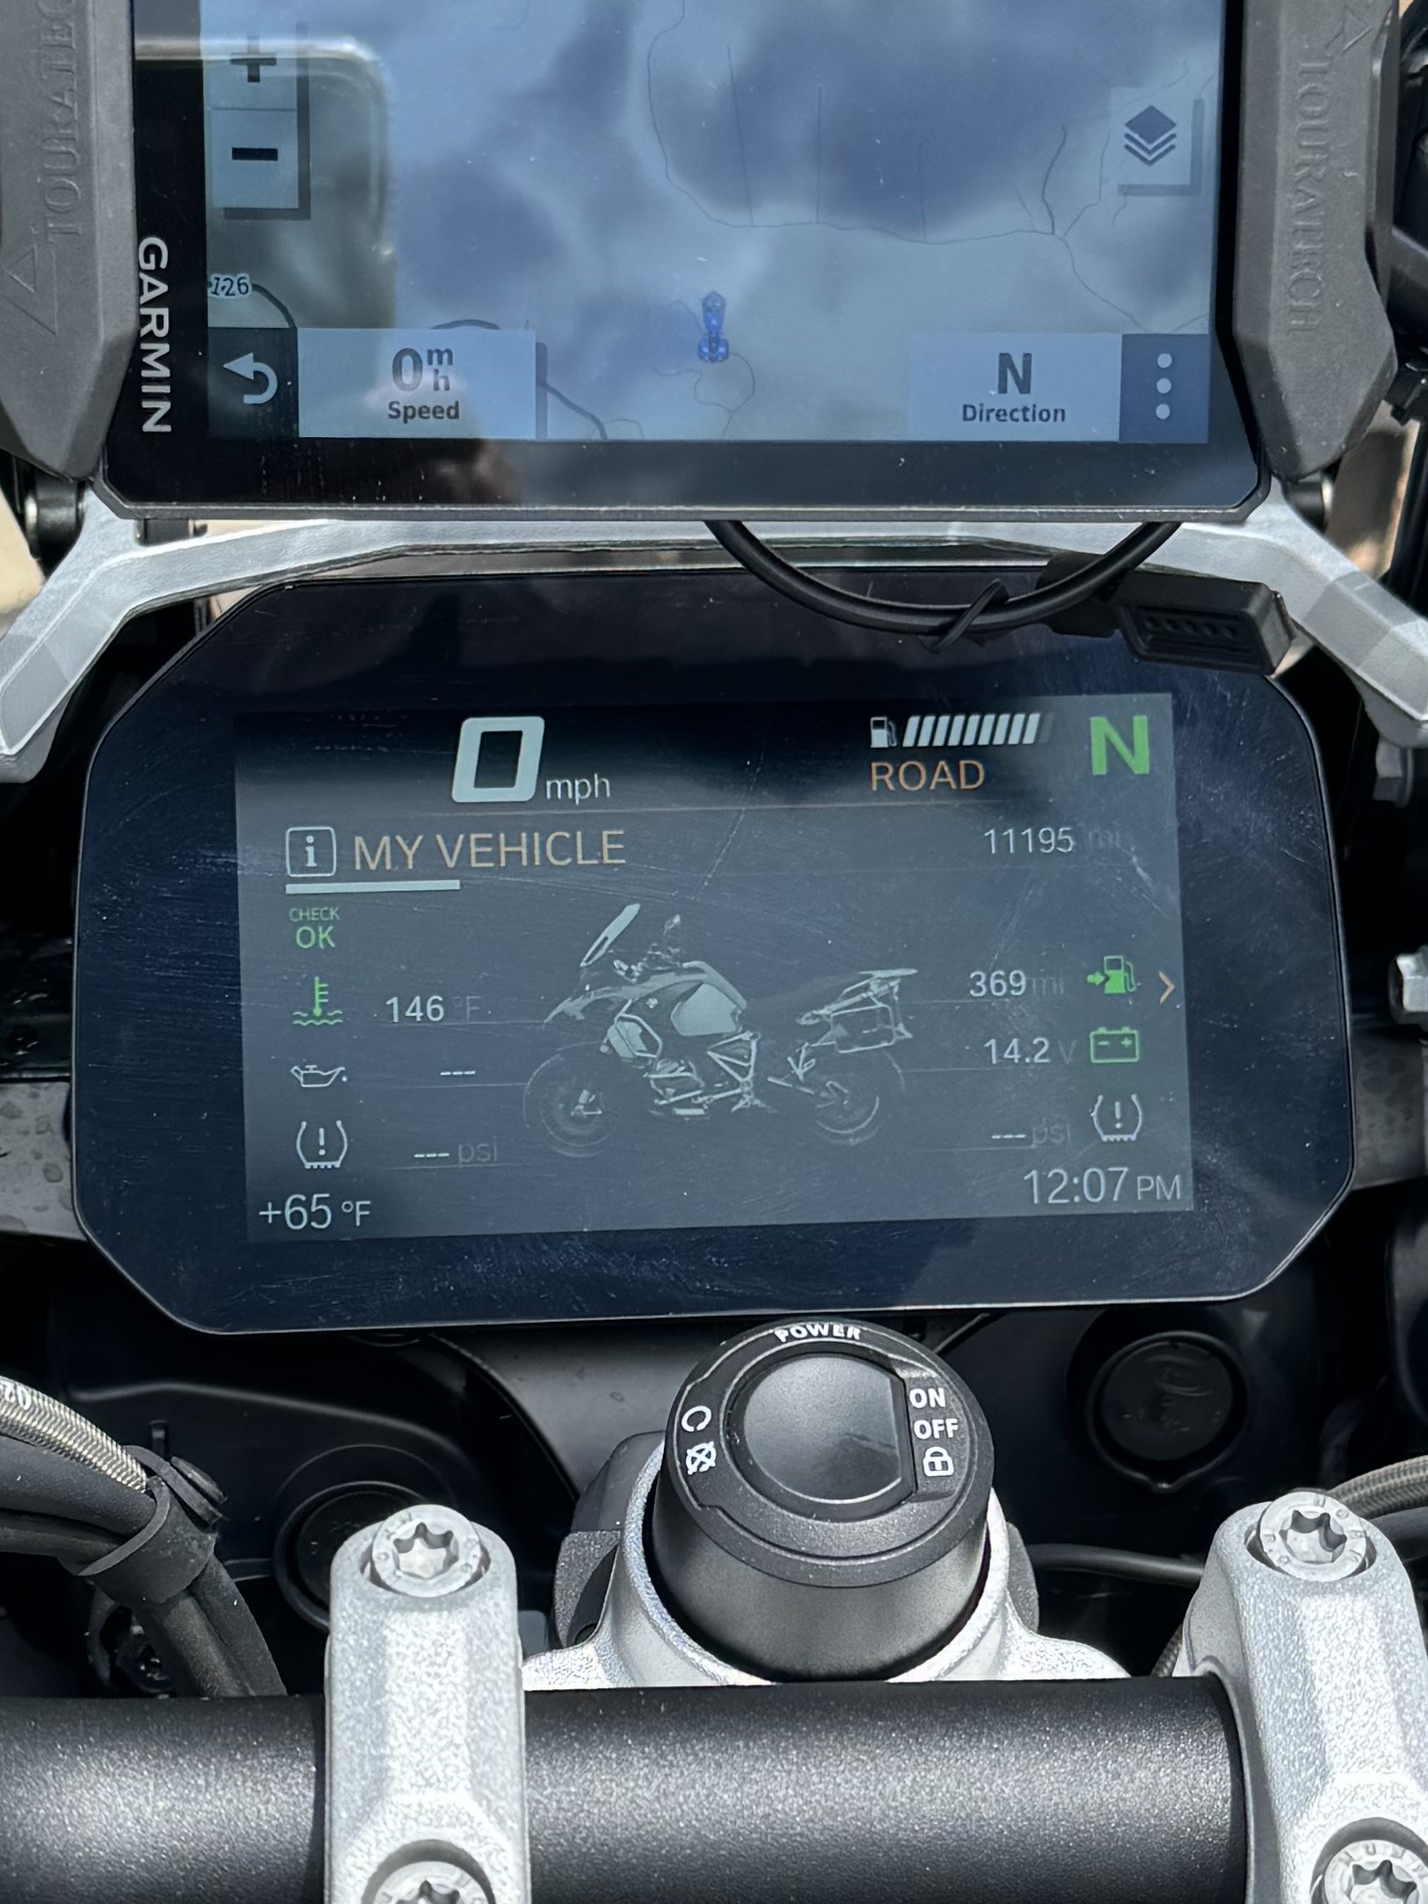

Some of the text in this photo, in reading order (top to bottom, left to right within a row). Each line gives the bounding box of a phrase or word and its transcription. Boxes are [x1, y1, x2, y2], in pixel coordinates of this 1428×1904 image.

[1288, 60, 1329, 336] TOURATECH
[208, 274, 251, 298] 126
[137, 236, 173, 434] GARMIN
[391, 347, 422, 392] 0
[997, 351, 1033, 395] N
[387, 399, 461, 424] Speed
[961, 401, 1067, 423] Direction
[1089, 714, 1151, 776] N
[451, 715, 611, 806] 0 mph
[871, 759, 986, 792] ROAD
[352, 829, 627, 871] MY VEHICLE
[983, 826, 1075, 855] 11195
[289, 906, 340, 922] CHECK
[295, 925, 336, 950] OK
[969, 969, 1027, 997] 369
[385, 994, 445, 1023] 146
[983, 1037, 1051, 1065] 14.2
[1023, 1166, 1182, 1205] 12:07 PM
[259, 1193, 371, 1230] +65 °F
[772, 1321, 863, 1342] POWER
[909, 1387, 947, 1409] ON
[913, 1417, 960, 1440] OFF
